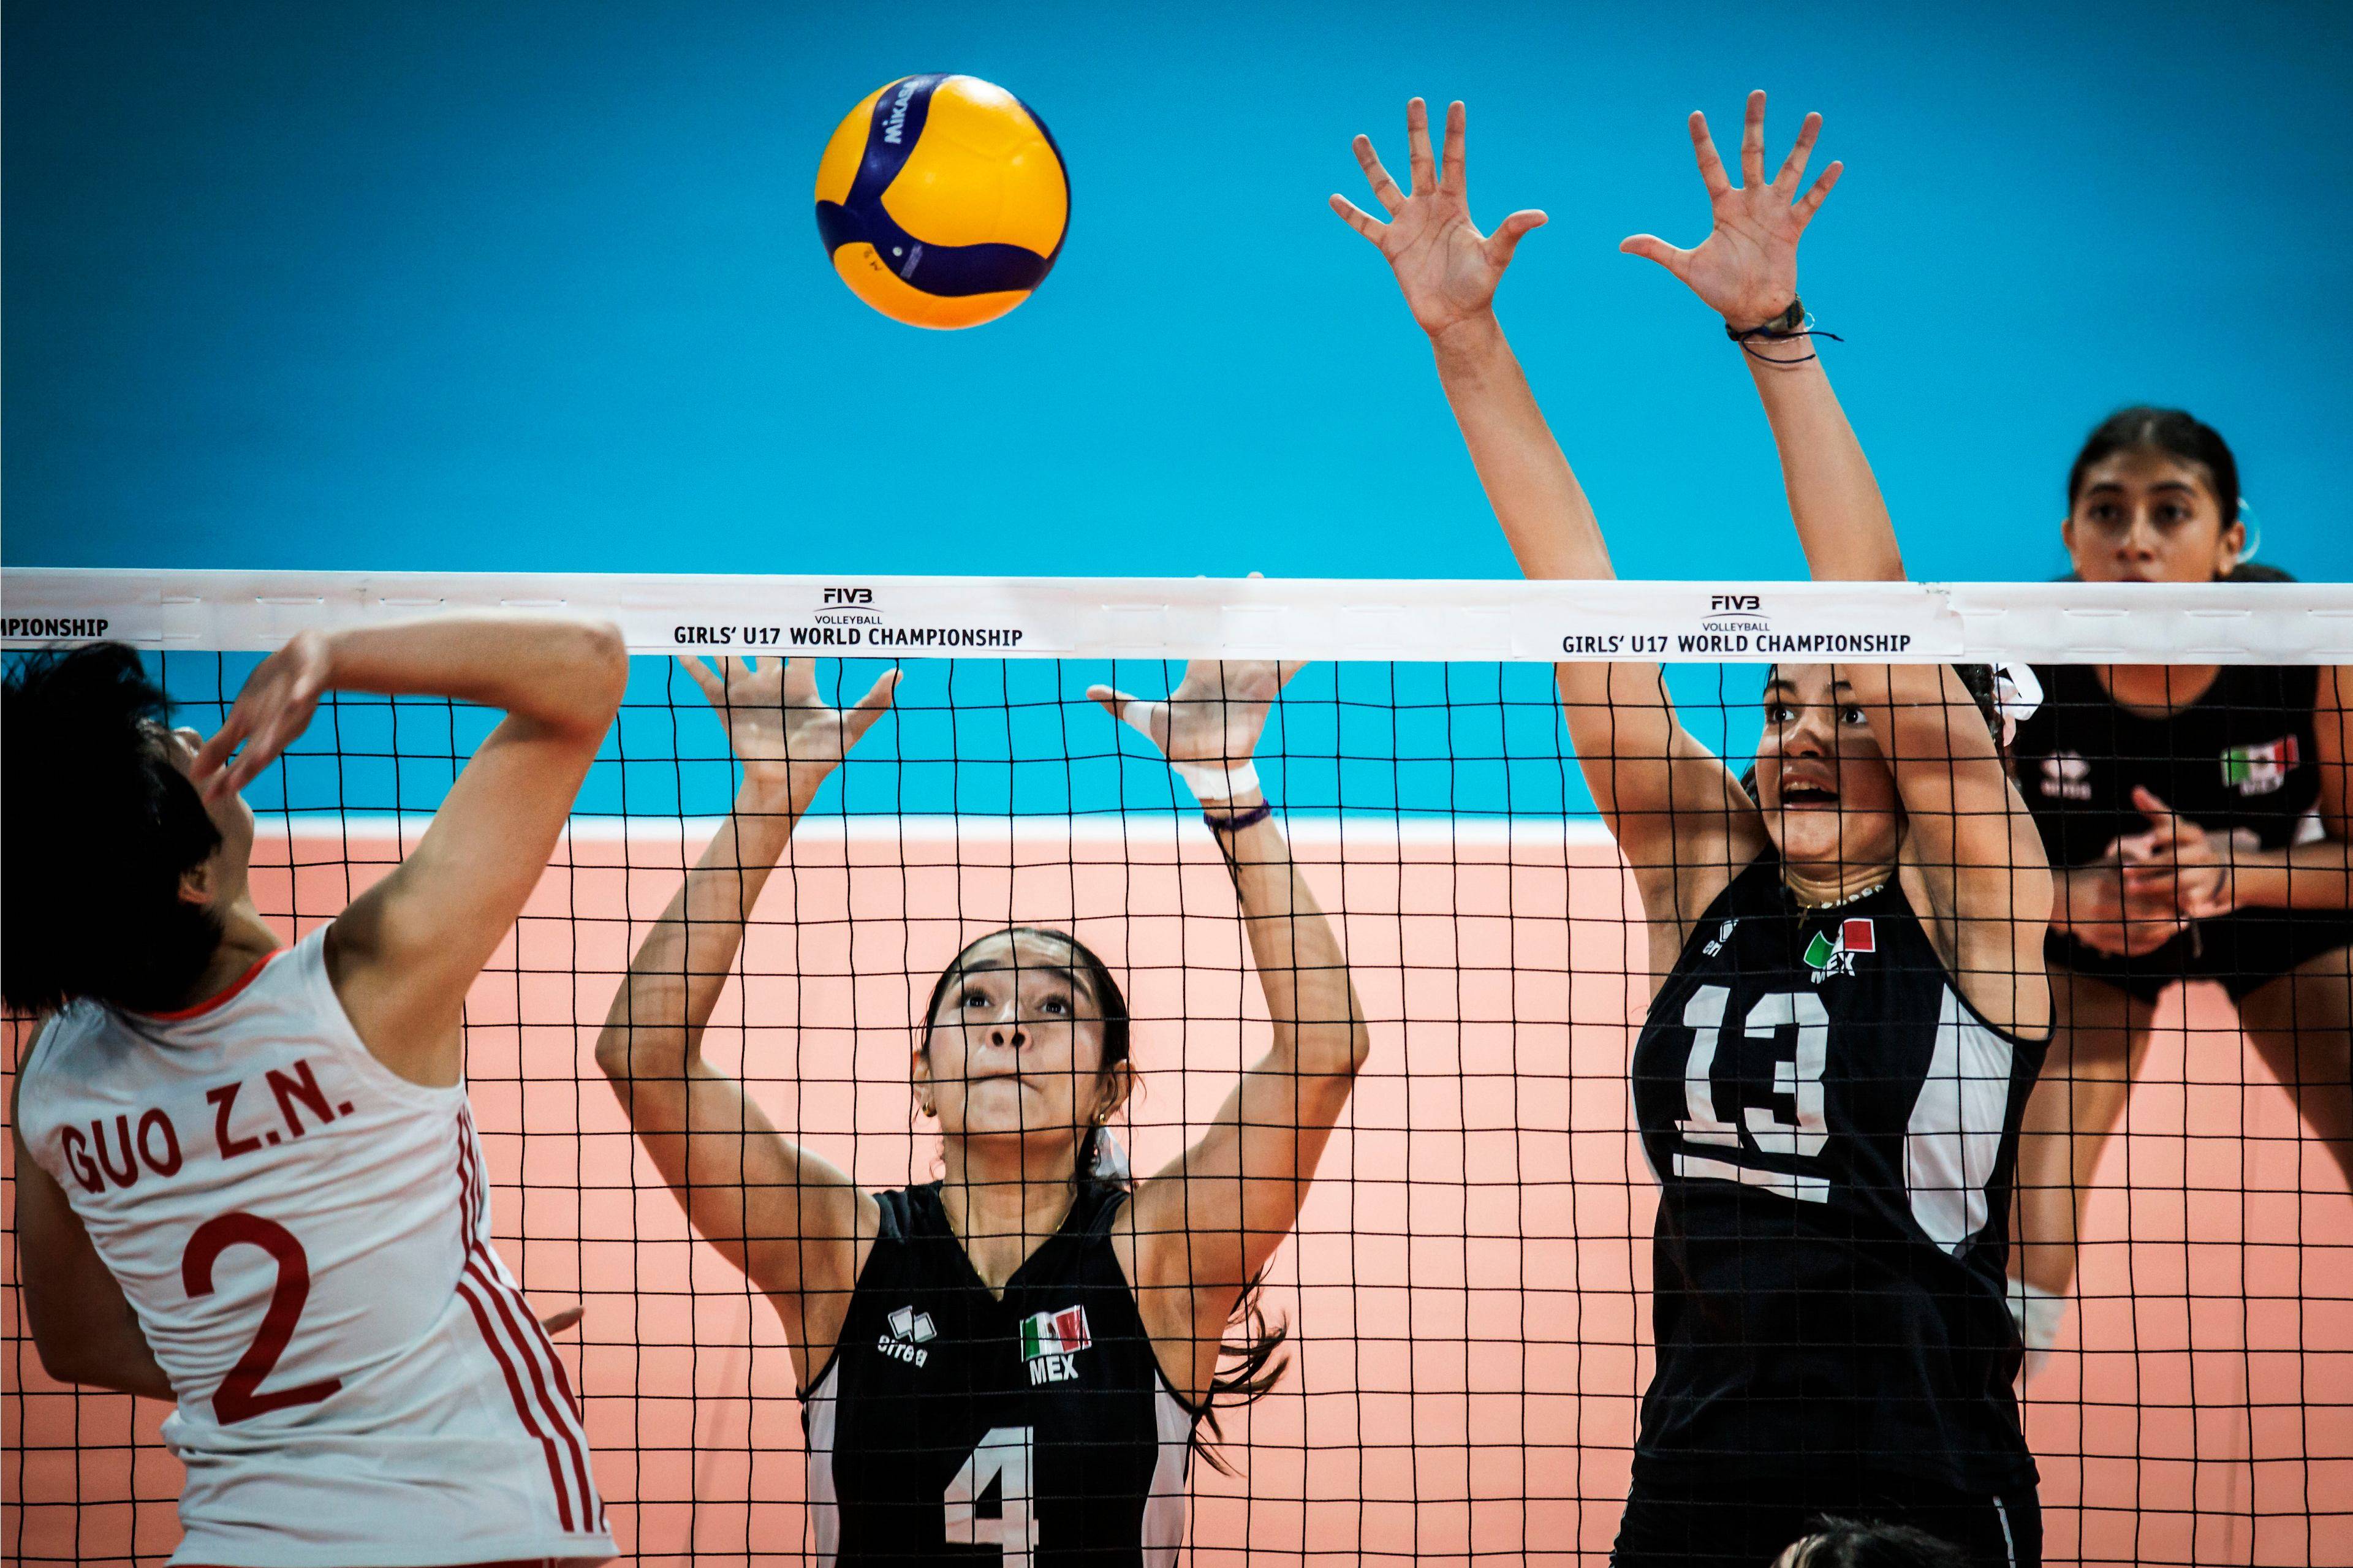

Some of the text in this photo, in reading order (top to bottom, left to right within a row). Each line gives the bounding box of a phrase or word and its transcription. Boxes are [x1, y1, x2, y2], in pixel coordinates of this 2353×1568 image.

[674, 626, 1023, 646] GIRLS' U17 WORLD CHAMPIONSHIP
[815, 616, 882, 625] VOLLEYBALL
[1702, 623, 1770, 632] VOLLEYBALL
[1563, 635, 1911, 653] GIRLS' U17 WORLD CHAMPIONSHIP
[1811, 952, 1856, 985] MEX
[1674, 984, 1829, 1157] 13
[62, 1059, 355, 1194] GUO Z.N.
[182, 1213, 343, 1426] 2
[1029, 1354, 1078, 1386] MEX
[944, 1426, 1039, 1568] 4
